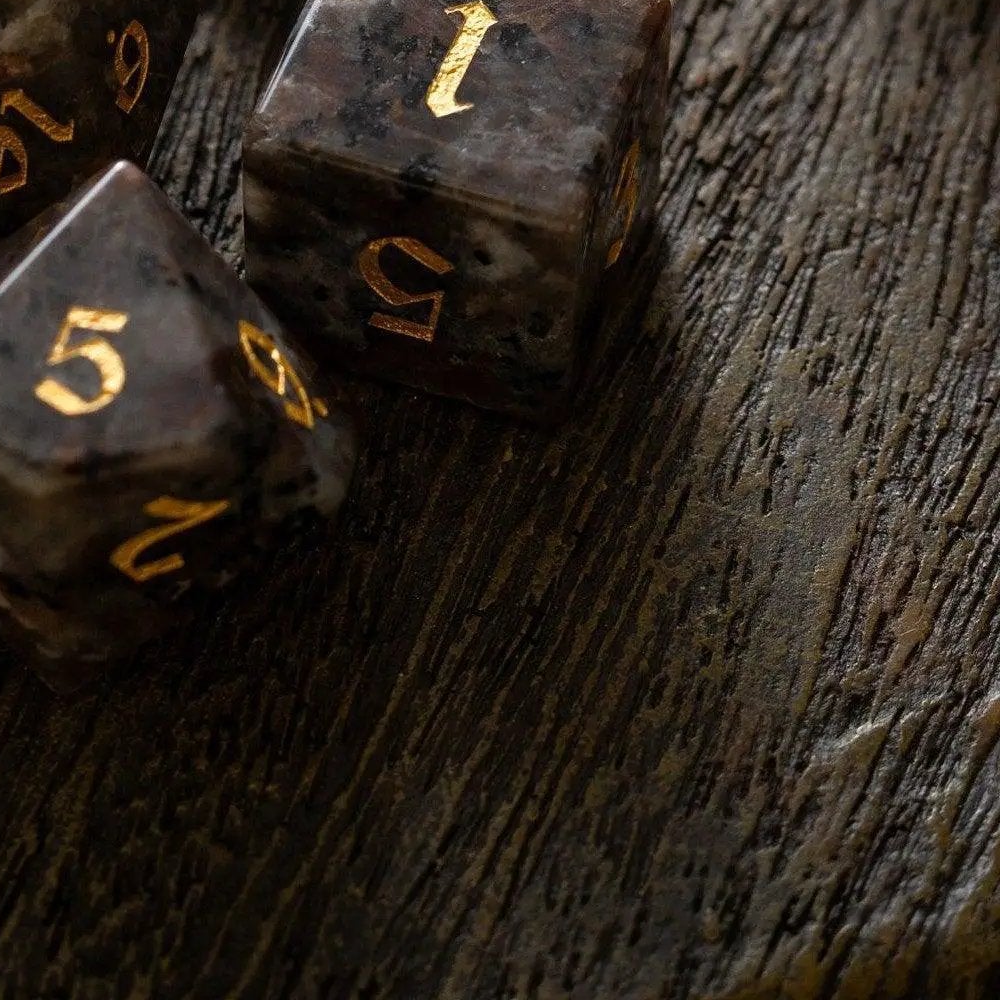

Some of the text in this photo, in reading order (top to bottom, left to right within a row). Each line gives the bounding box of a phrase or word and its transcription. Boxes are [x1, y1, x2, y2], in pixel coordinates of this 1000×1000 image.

[425, 0, 498, 118] 1
[358, 236, 453, 342] 5
[34, 306, 129, 417] 5
